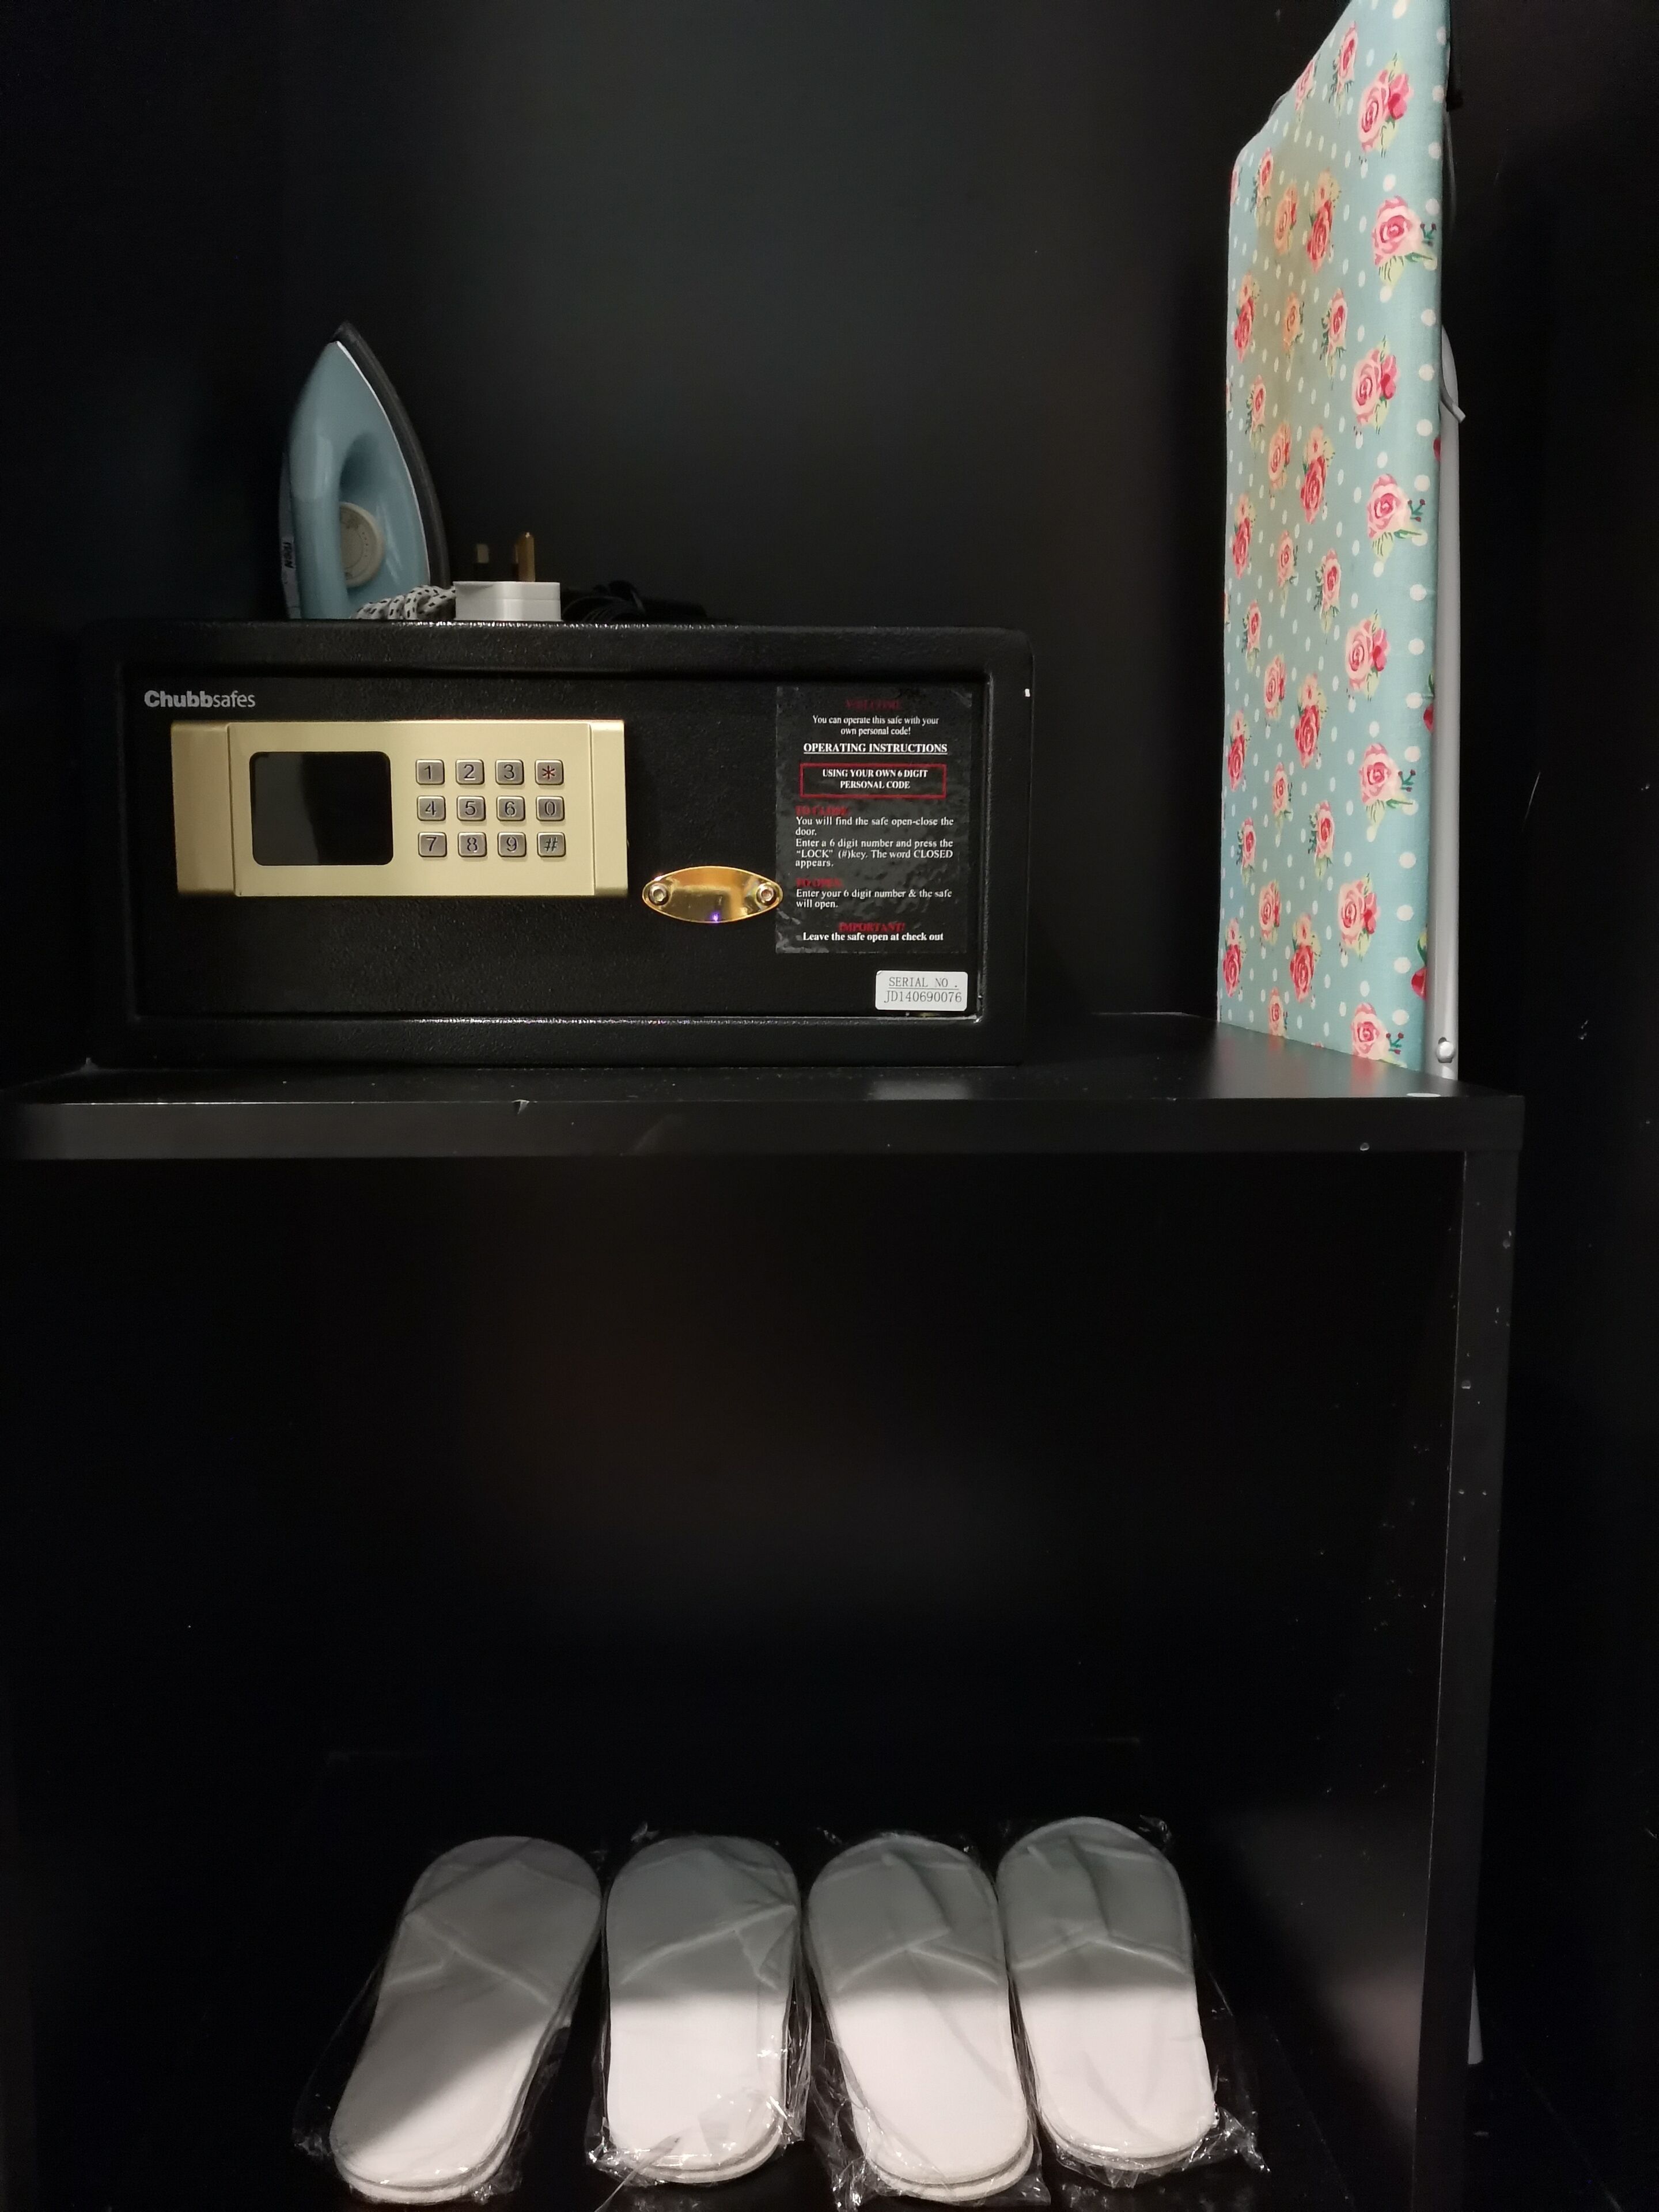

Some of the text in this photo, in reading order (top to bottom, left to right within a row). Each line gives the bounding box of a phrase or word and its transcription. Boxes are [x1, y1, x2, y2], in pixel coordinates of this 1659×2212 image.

[144, 690, 256, 708] Chubbsafes
[812, 715, 827, 724] You
[843, 717, 871, 726] operate
[872, 715, 886, 724] this
[887, 715, 903, 724] safe
[904, 715, 921, 725] with
[922, 718, 940, 726] your
[858, 726, 889, 737] personal
[891, 726, 911, 735] code!
[803, 743, 948, 753] OPERATING INSTRUCTIONS
[423, 764, 515, 780] 1 2 3
[822, 768, 929, 778] USING YOUR OWN 6 DIGIT
[840, 780, 911, 789] PERSONAL CODE
[425, 800, 556, 816] 4 5 6 0
[796, 816, 813, 825] You
[815, 816, 832, 825] will
[835, 816, 853, 825] find
[855, 816, 869, 826] the
[871, 816, 889, 825] safe
[941, 816, 954, 826] the
[795, 827, 817, 836] door.
[425, 836, 437, 852] 7
[466, 837, 478, 853] 8
[506, 836, 518, 853] 9
[796, 838, 820, 847] Enter
[829, 838, 835, 847] 6
[837, 838, 858, 849] digit
[861, 838, 894, 848] number
[895, 838, 912, 848] and
[914, 840, 937, 850] press
[940, 838, 953, 847] the
[870, 849, 888, 859] The
[889, 849, 911, 859] word
[913, 849, 953, 859] CLOSED
[796, 888, 952, 899] Enter your 6 digit number & the safe
[796, 899, 839, 910] will open.
[802, 931, 944, 942] Leave the safe open at check out
[889, 976, 929, 987] SERIAL
[884, 990, 963, 1003] JD140690076
